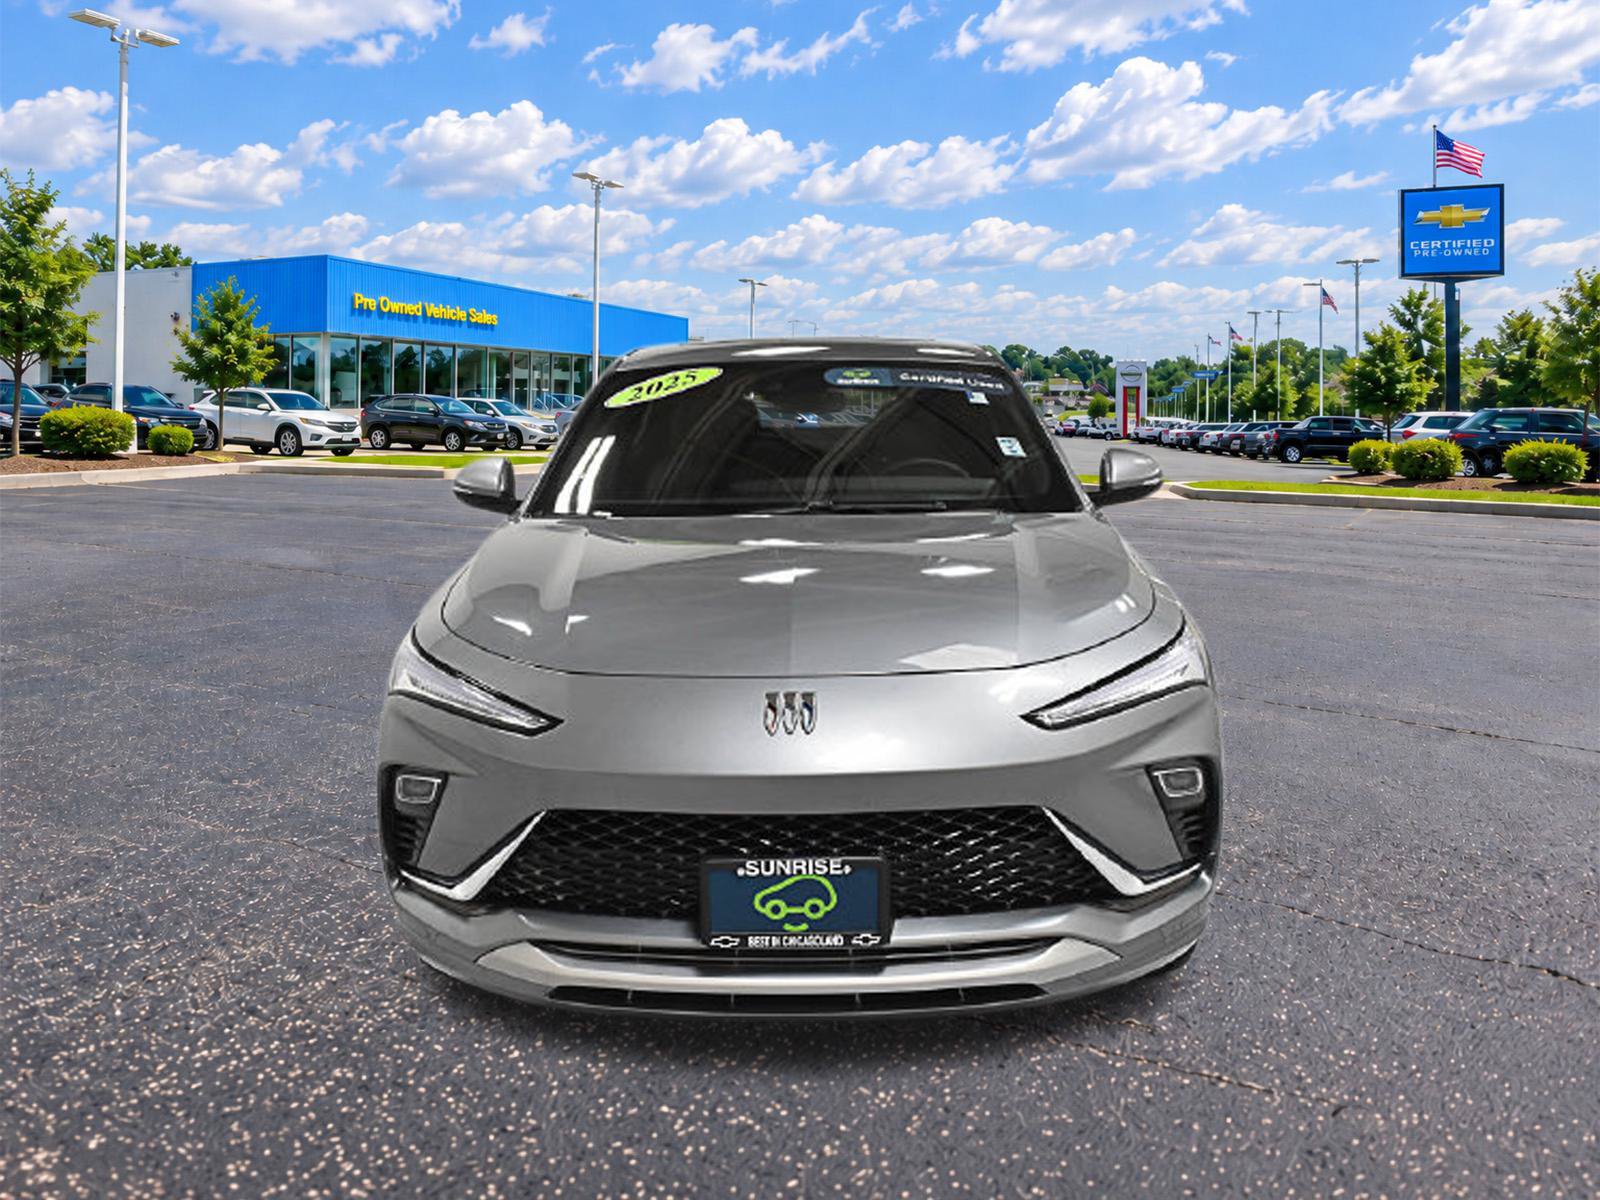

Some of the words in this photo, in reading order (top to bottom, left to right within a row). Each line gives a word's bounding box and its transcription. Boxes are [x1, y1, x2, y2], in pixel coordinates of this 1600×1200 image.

[1410, 238, 1495, 250] CERTIFIED
[1413, 248, 1490, 257] PRE-OWNED
[353, 293, 376, 311] Pre
[379, 296, 422, 317] Owned
[424, 301, 467, 322] Vehicle
[469, 307, 498, 326] Sales
[745, 858, 844, 877] SUNRISE
[748, 935, 770, 948] BEST
